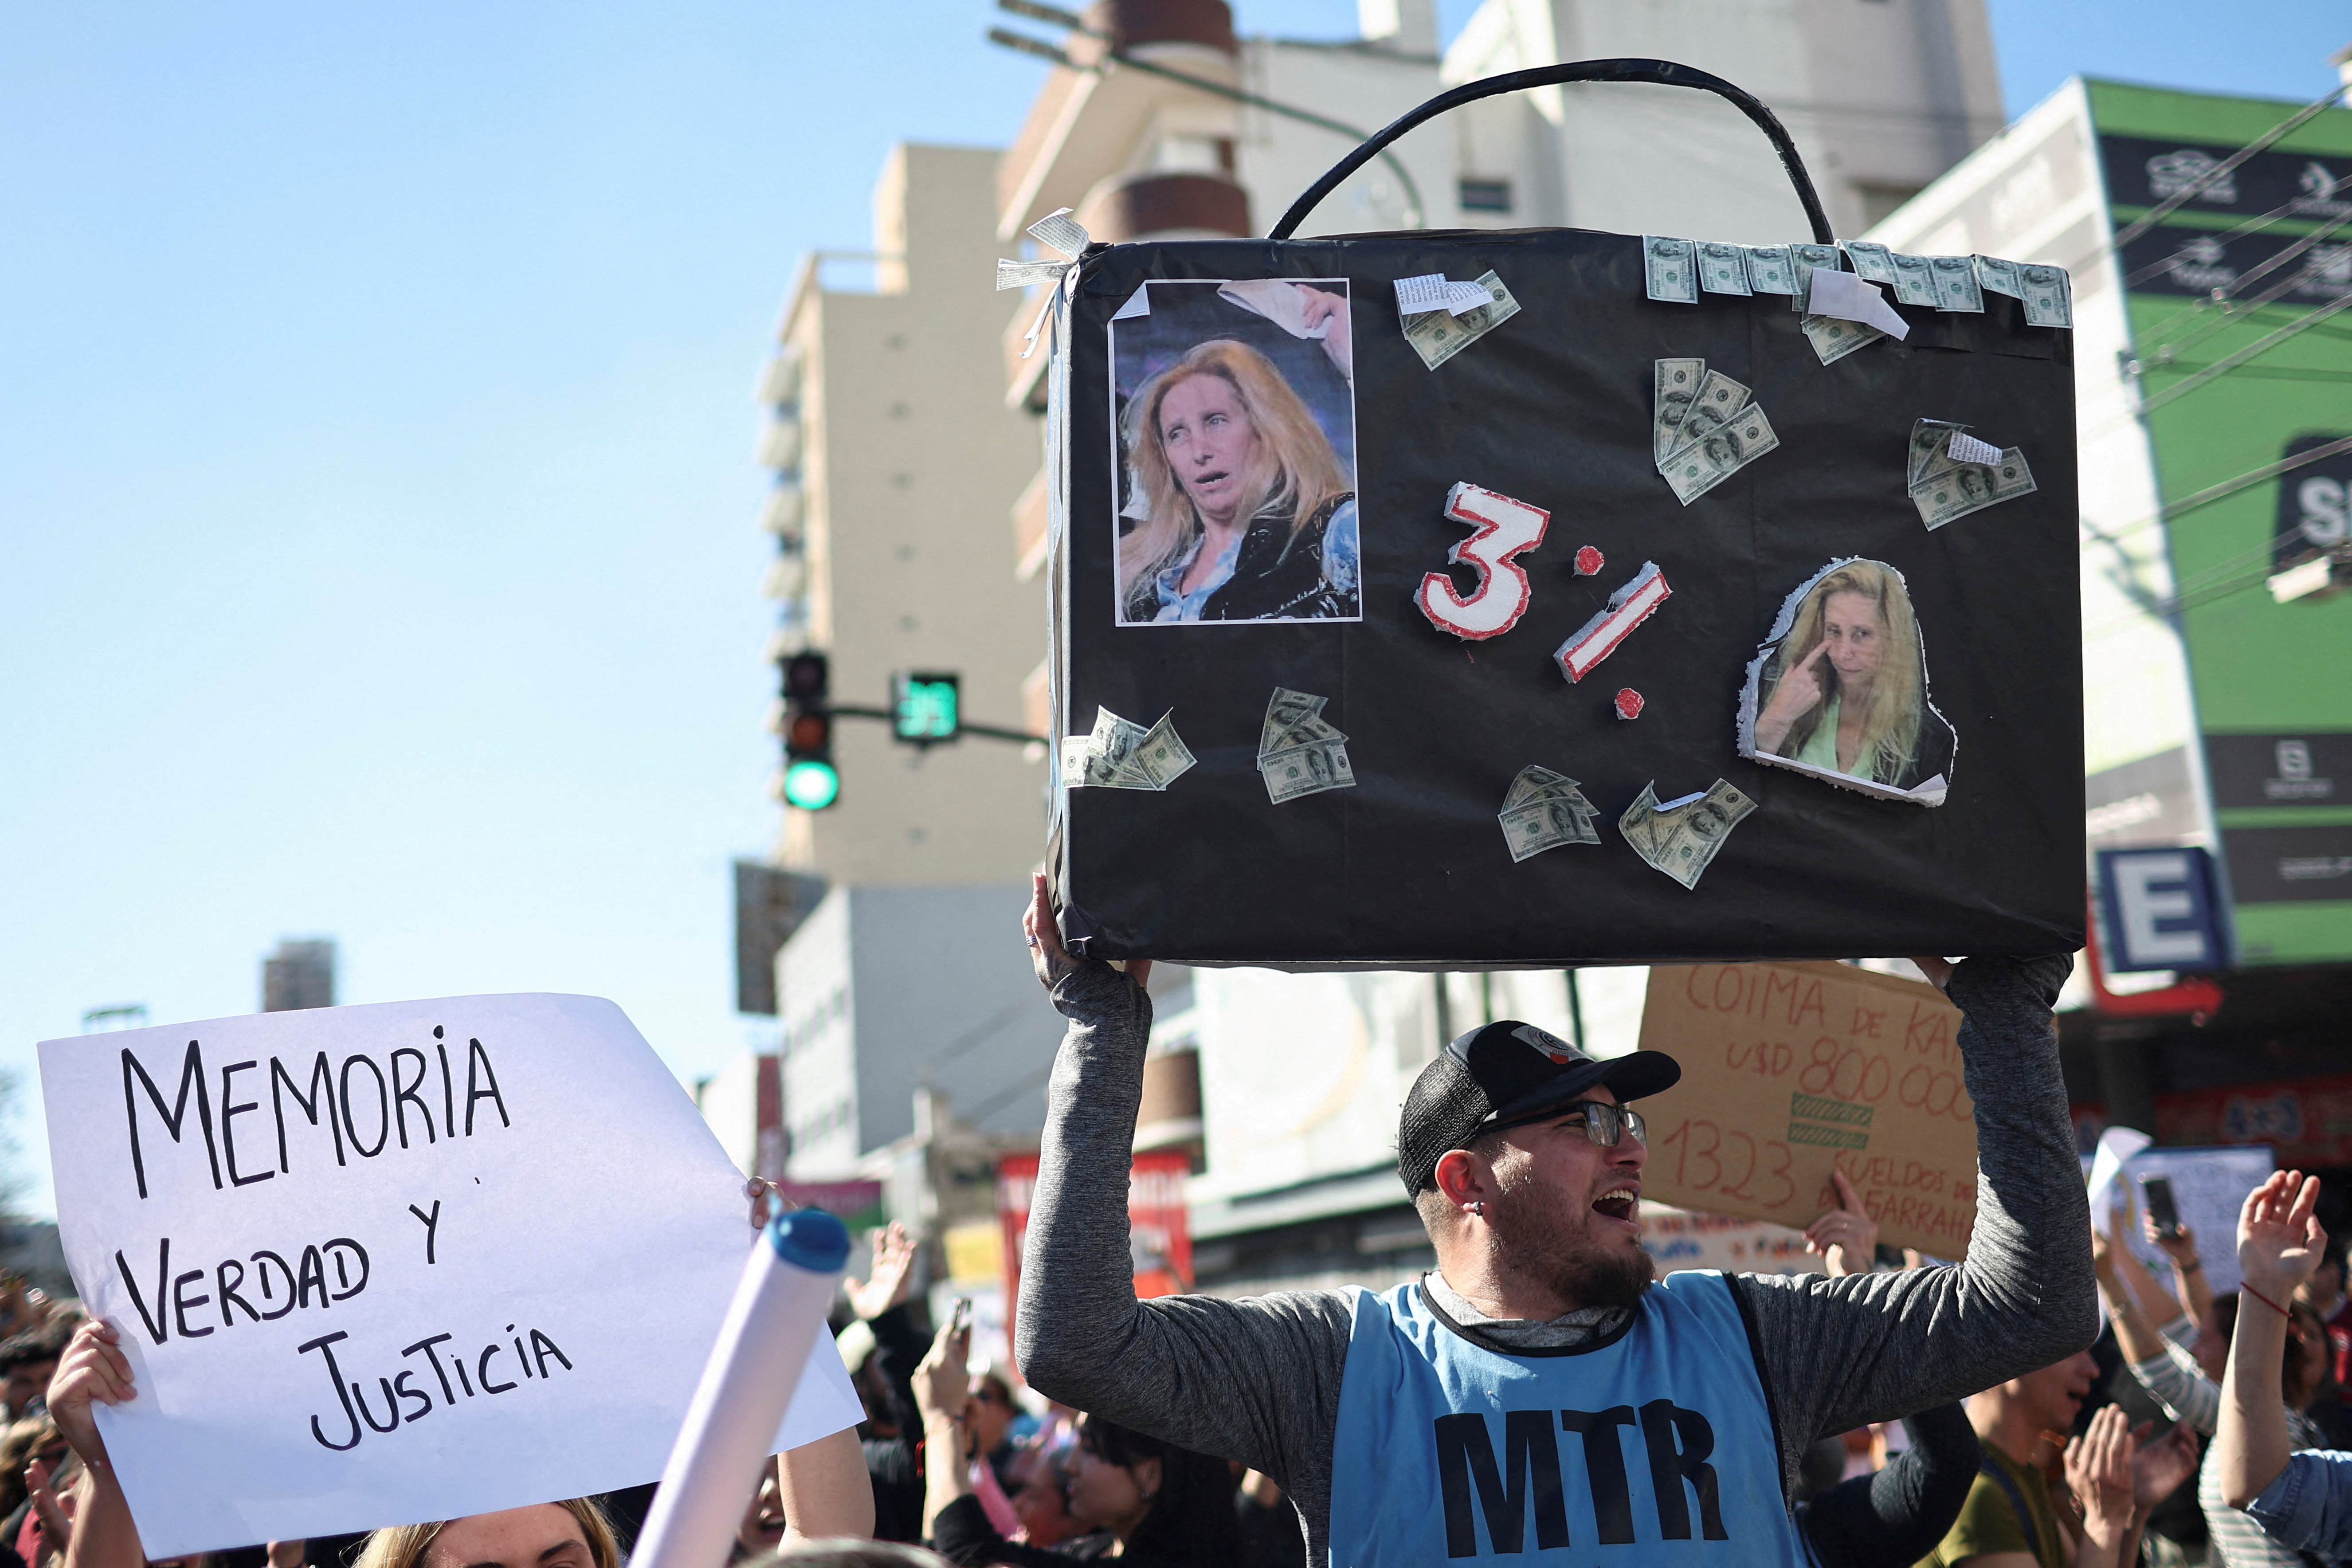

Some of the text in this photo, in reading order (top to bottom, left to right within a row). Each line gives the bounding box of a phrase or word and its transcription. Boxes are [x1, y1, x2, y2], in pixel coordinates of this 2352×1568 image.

[2112, 852, 2204, 966] E
[1686, 964, 1960, 1064] COIMA DE KA
[122, 1024, 510, 1200] MEMORIA
[1662, 1118, 1797, 1210] 1323
[1833, 1149, 1948, 1193] SUELDOS
[115, 1200, 440, 1345] VERDAD Y
[298, 1322, 573, 1451] JUSTICIA
[1434, 1399, 1729, 1559] MTR
